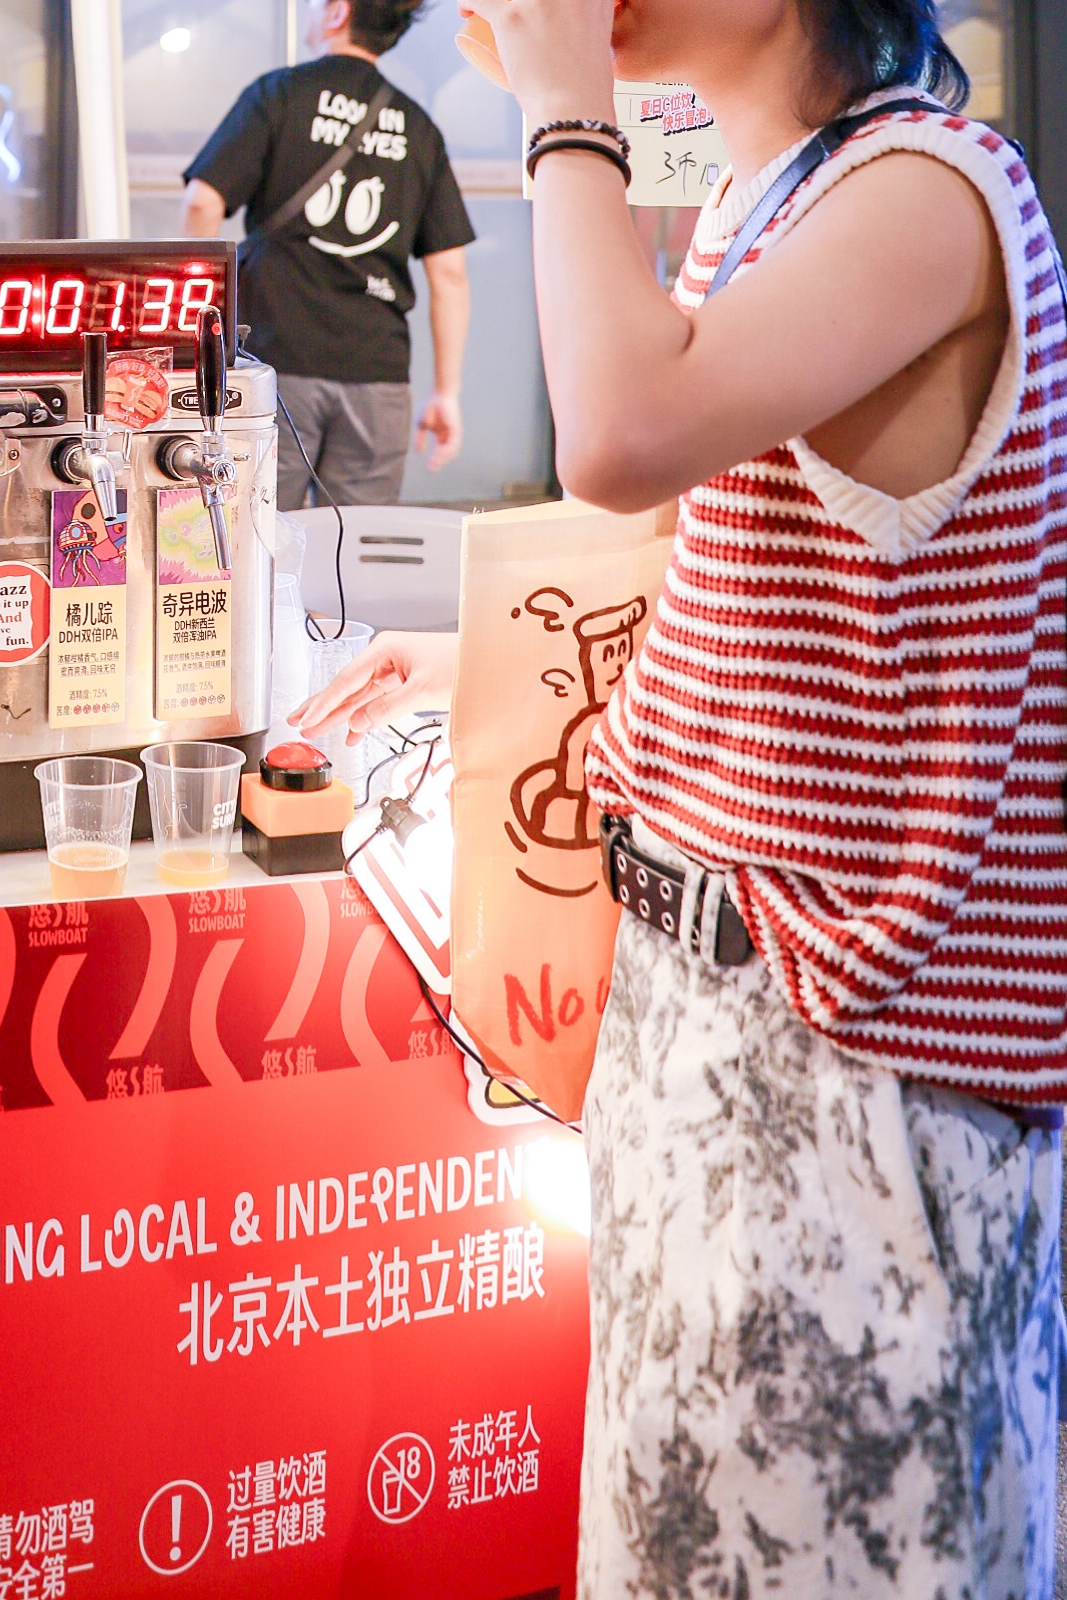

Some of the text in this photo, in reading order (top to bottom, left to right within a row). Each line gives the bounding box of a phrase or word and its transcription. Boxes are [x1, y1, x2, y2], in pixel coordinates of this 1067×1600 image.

[310, 116, 351, 147] MY
[378, 107, 405, 134] IN
[3, 599, 30, 610] it up
[65, 600, 114, 628] 橘儿踪
[162, 589, 228, 618] 奇异电波
[58, 627, 119, 644] DDH双倍IPA
[172, 630, 218, 644] 双倍浑浊IPA
[174, 617, 215, 630] DDH新西兰
[6, 635, 30, 647] fun.
[28, 927, 88, 947] SLOWBOAT
[188, 913, 245, 933] SLOWBOAT
[80, 1197, 218, 1273] LOCAL
[230, 1191, 263, 1246] &
[177, 1220, 545, 1366] 北京本土独立精酿
[449, 1404, 541, 1463] 未成年人
[227, 1449, 328, 1513] 过量饮酒
[447, 1449, 540, 1510] 禁止饮酒
[226, 1496, 327, 1560] 有害健康
